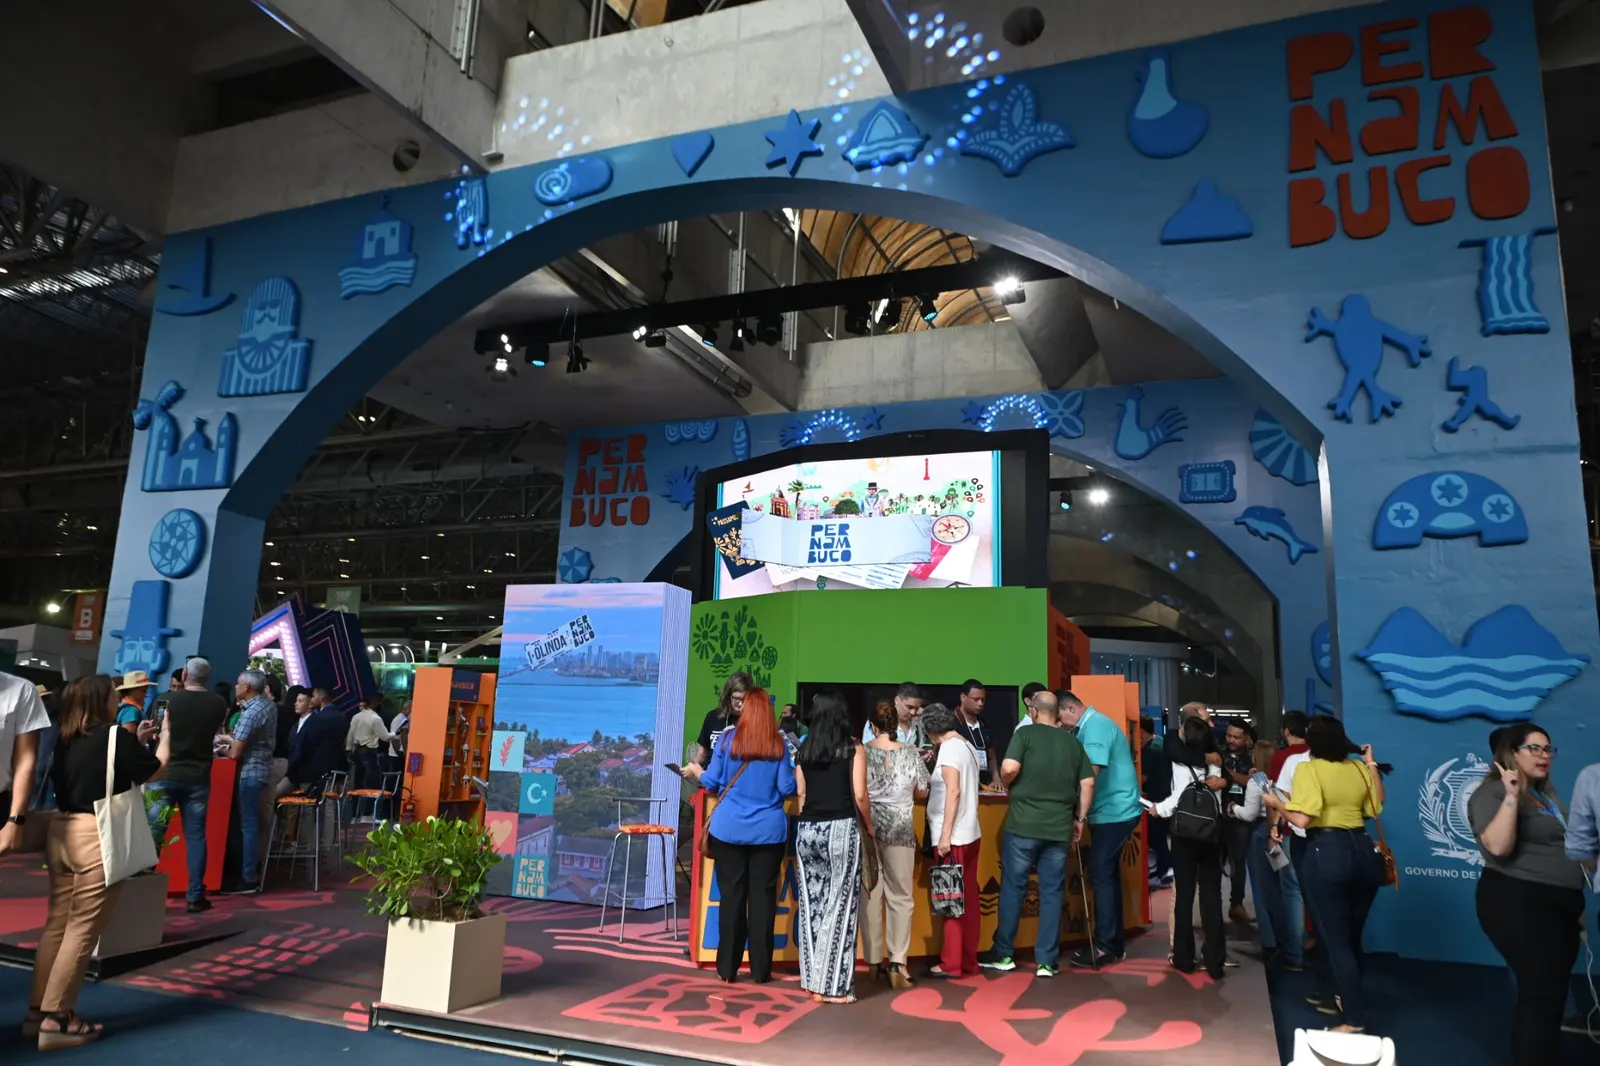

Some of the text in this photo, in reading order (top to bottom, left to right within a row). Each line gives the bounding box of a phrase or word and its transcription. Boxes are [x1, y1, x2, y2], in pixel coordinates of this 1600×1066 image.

[1287, 7, 1496, 101] PER
[1289, 146, 1531, 248] BUCO
[579, 433, 648, 467] PER
[570, 495, 650, 527] BUCO
[811, 523, 850, 537] PER
[807, 549, 851, 564] BUCO
[80, 608, 93, 628] B
[534, 634, 567, 660] OLINDA
[520, 858, 545, 871] PER
[1405, 866, 1459, 879] GOVERNO
[1461, 870, 1477, 880] DE
[516, 882, 545, 897] BUCO
